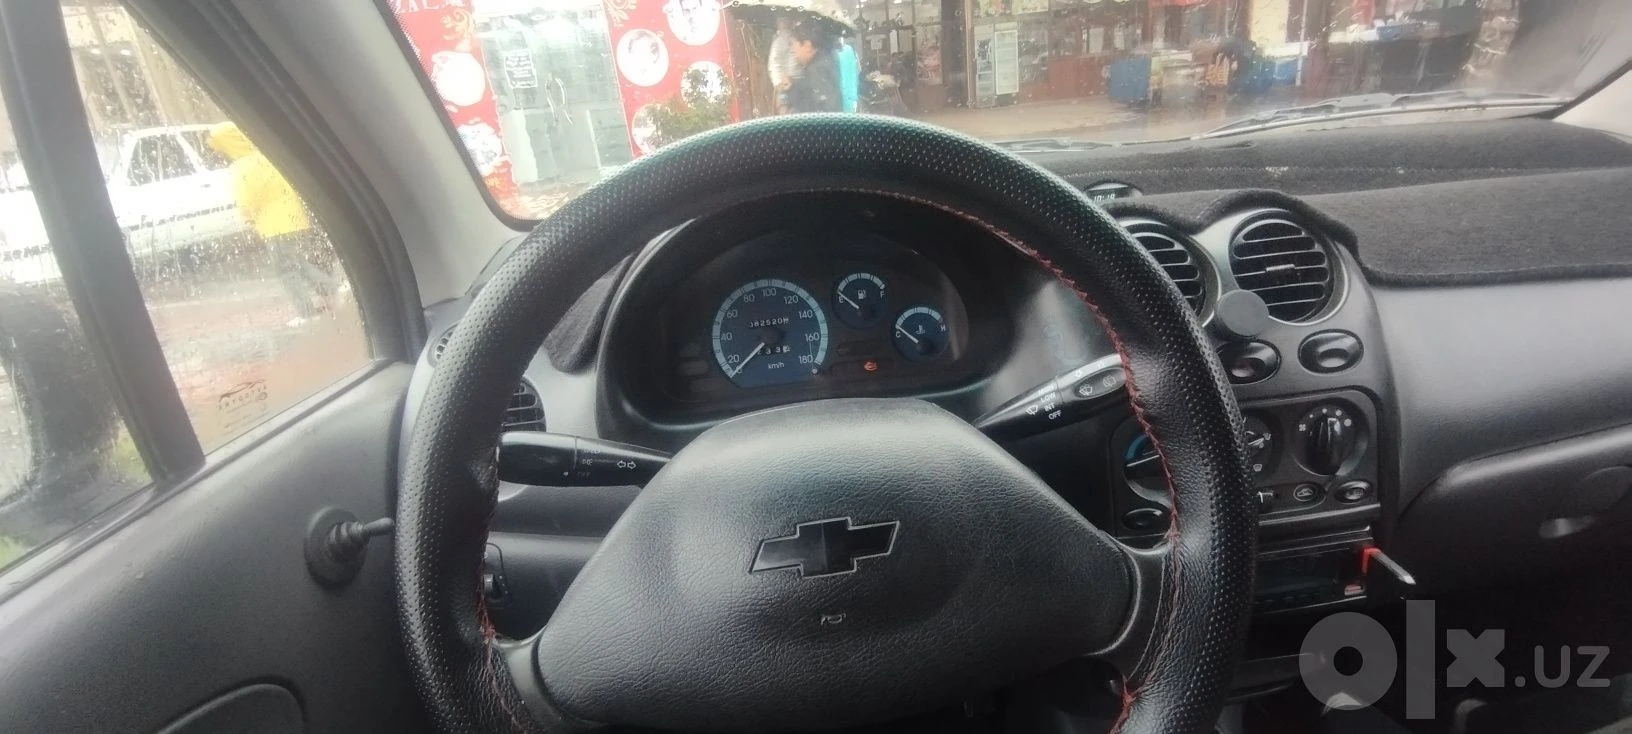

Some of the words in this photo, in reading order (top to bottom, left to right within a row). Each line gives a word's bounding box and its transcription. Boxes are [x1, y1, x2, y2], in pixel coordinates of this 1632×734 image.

[762, 288, 777, 297] 100
[743, 294, 756, 303] 80
[784, 295, 799, 304] 120
[727, 309, 738, 319] 60
[798, 310, 813, 319] 140
[720, 332, 733, 341] 40
[805, 333, 819, 342] 160
[727, 355, 740, 364] 20
[798, 355, 813, 364] 180
[1040, 392, 1057, 403] LOW
[1044, 403, 1055, 412] INT
[1048, 410, 1062, 420] OFF
